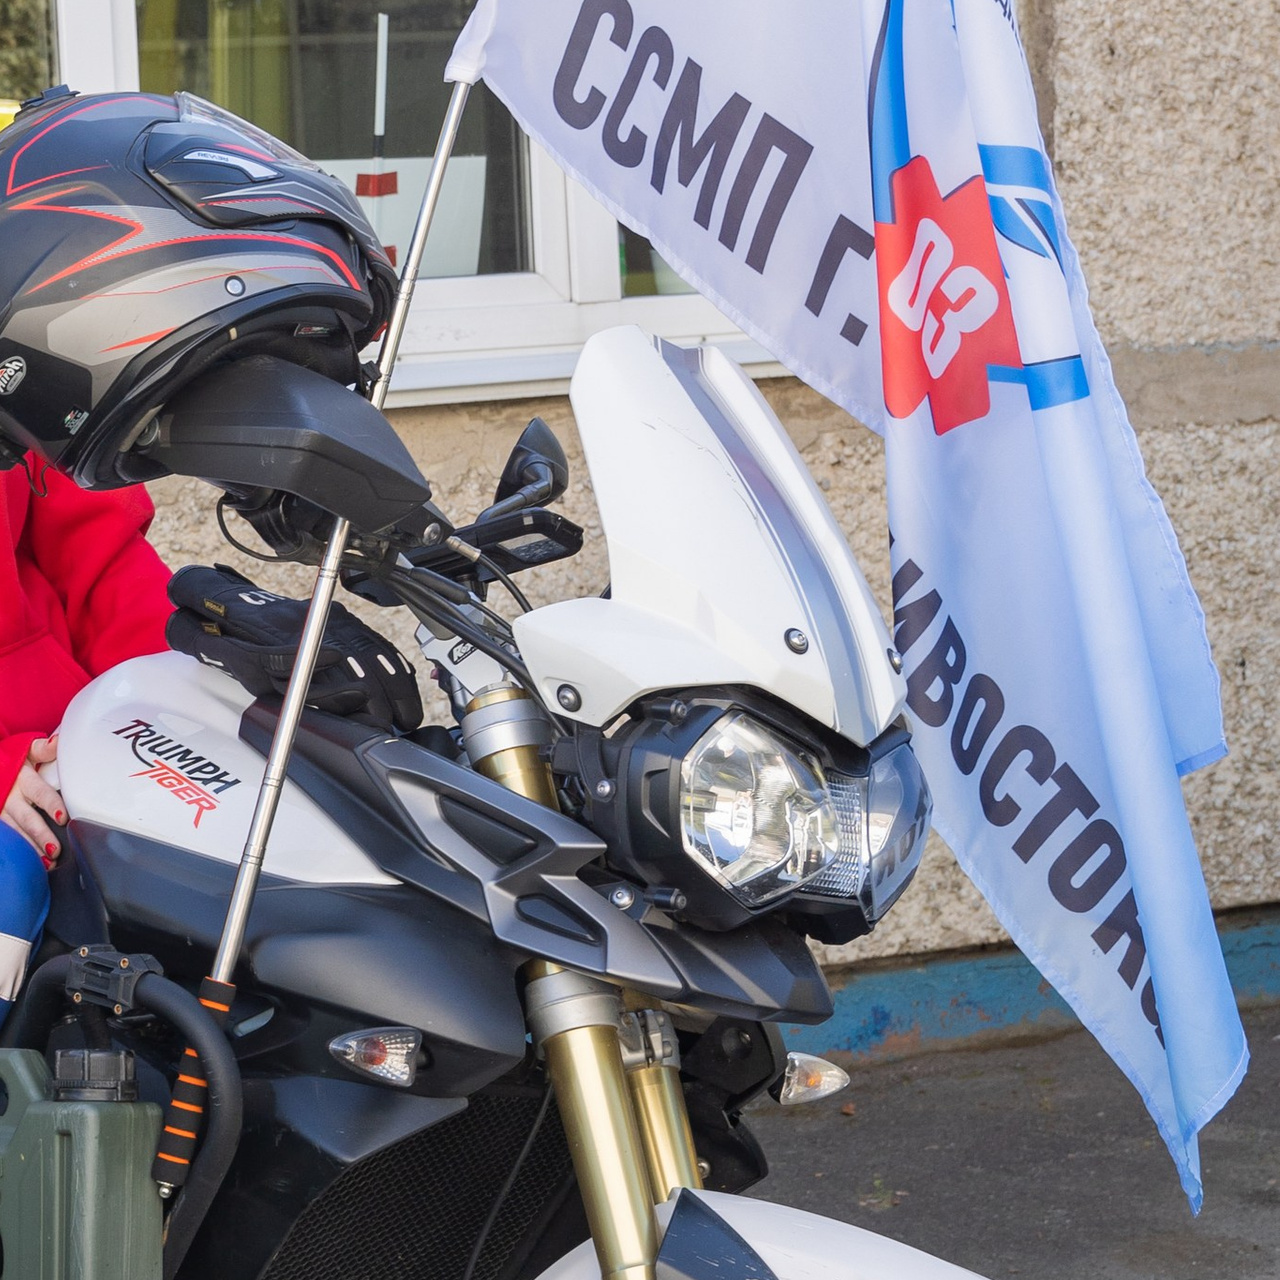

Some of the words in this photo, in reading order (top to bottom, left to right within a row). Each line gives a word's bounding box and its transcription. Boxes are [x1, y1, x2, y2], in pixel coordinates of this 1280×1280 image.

[887, 217, 999, 379] 03
[112, 719, 242, 795] TRIUMPH
[128, 759, 221, 829] TIGER
